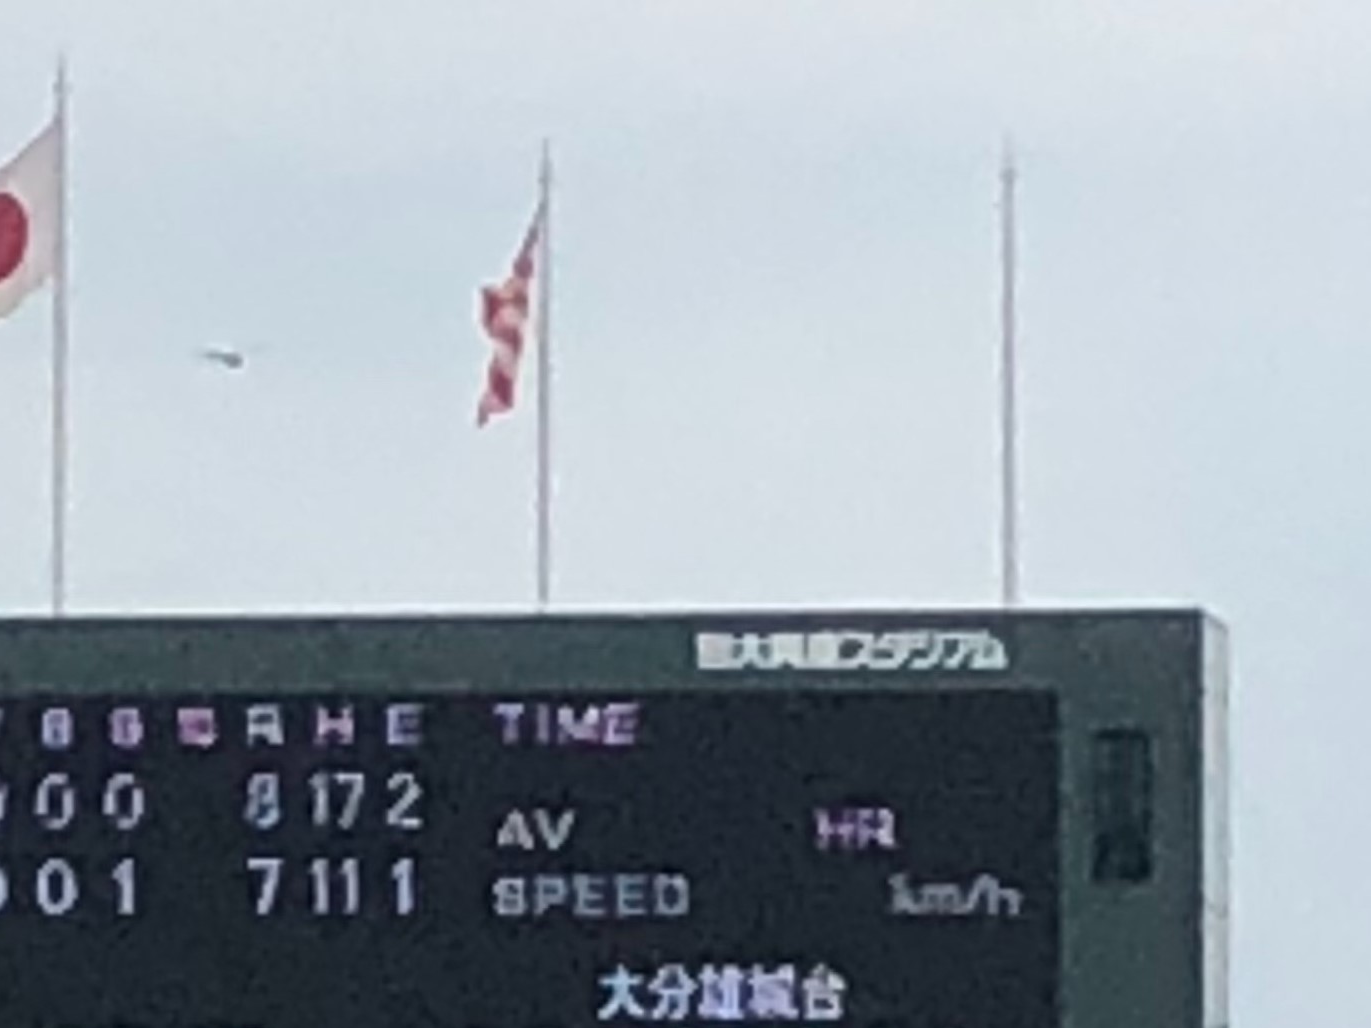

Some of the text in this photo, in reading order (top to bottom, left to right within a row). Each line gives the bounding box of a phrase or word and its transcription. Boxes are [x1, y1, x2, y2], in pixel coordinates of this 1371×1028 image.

[246, 704, 284, 746] R
[316, 706, 354, 746] H
[386, 703, 419, 746] E
[494, 703, 638, 745] TIME
[35, 773, 75, 830] 0
[103, 773, 144, 830] 0
[245, 773, 280, 829] 8
[309, 772, 365, 829] 17
[386, 772, 422, 829] 2
[497, 809, 574, 850] AV
[816, 807, 897, 848] HR
[36, 858, 78, 915] 0
[112, 858, 134, 915] 1
[247, 858, 283, 915] 7
[311, 858, 359, 914] 11
[392, 858, 414, 915] 1
[492, 873, 690, 917] SPEED
[887, 872, 1024, 916] km/h
